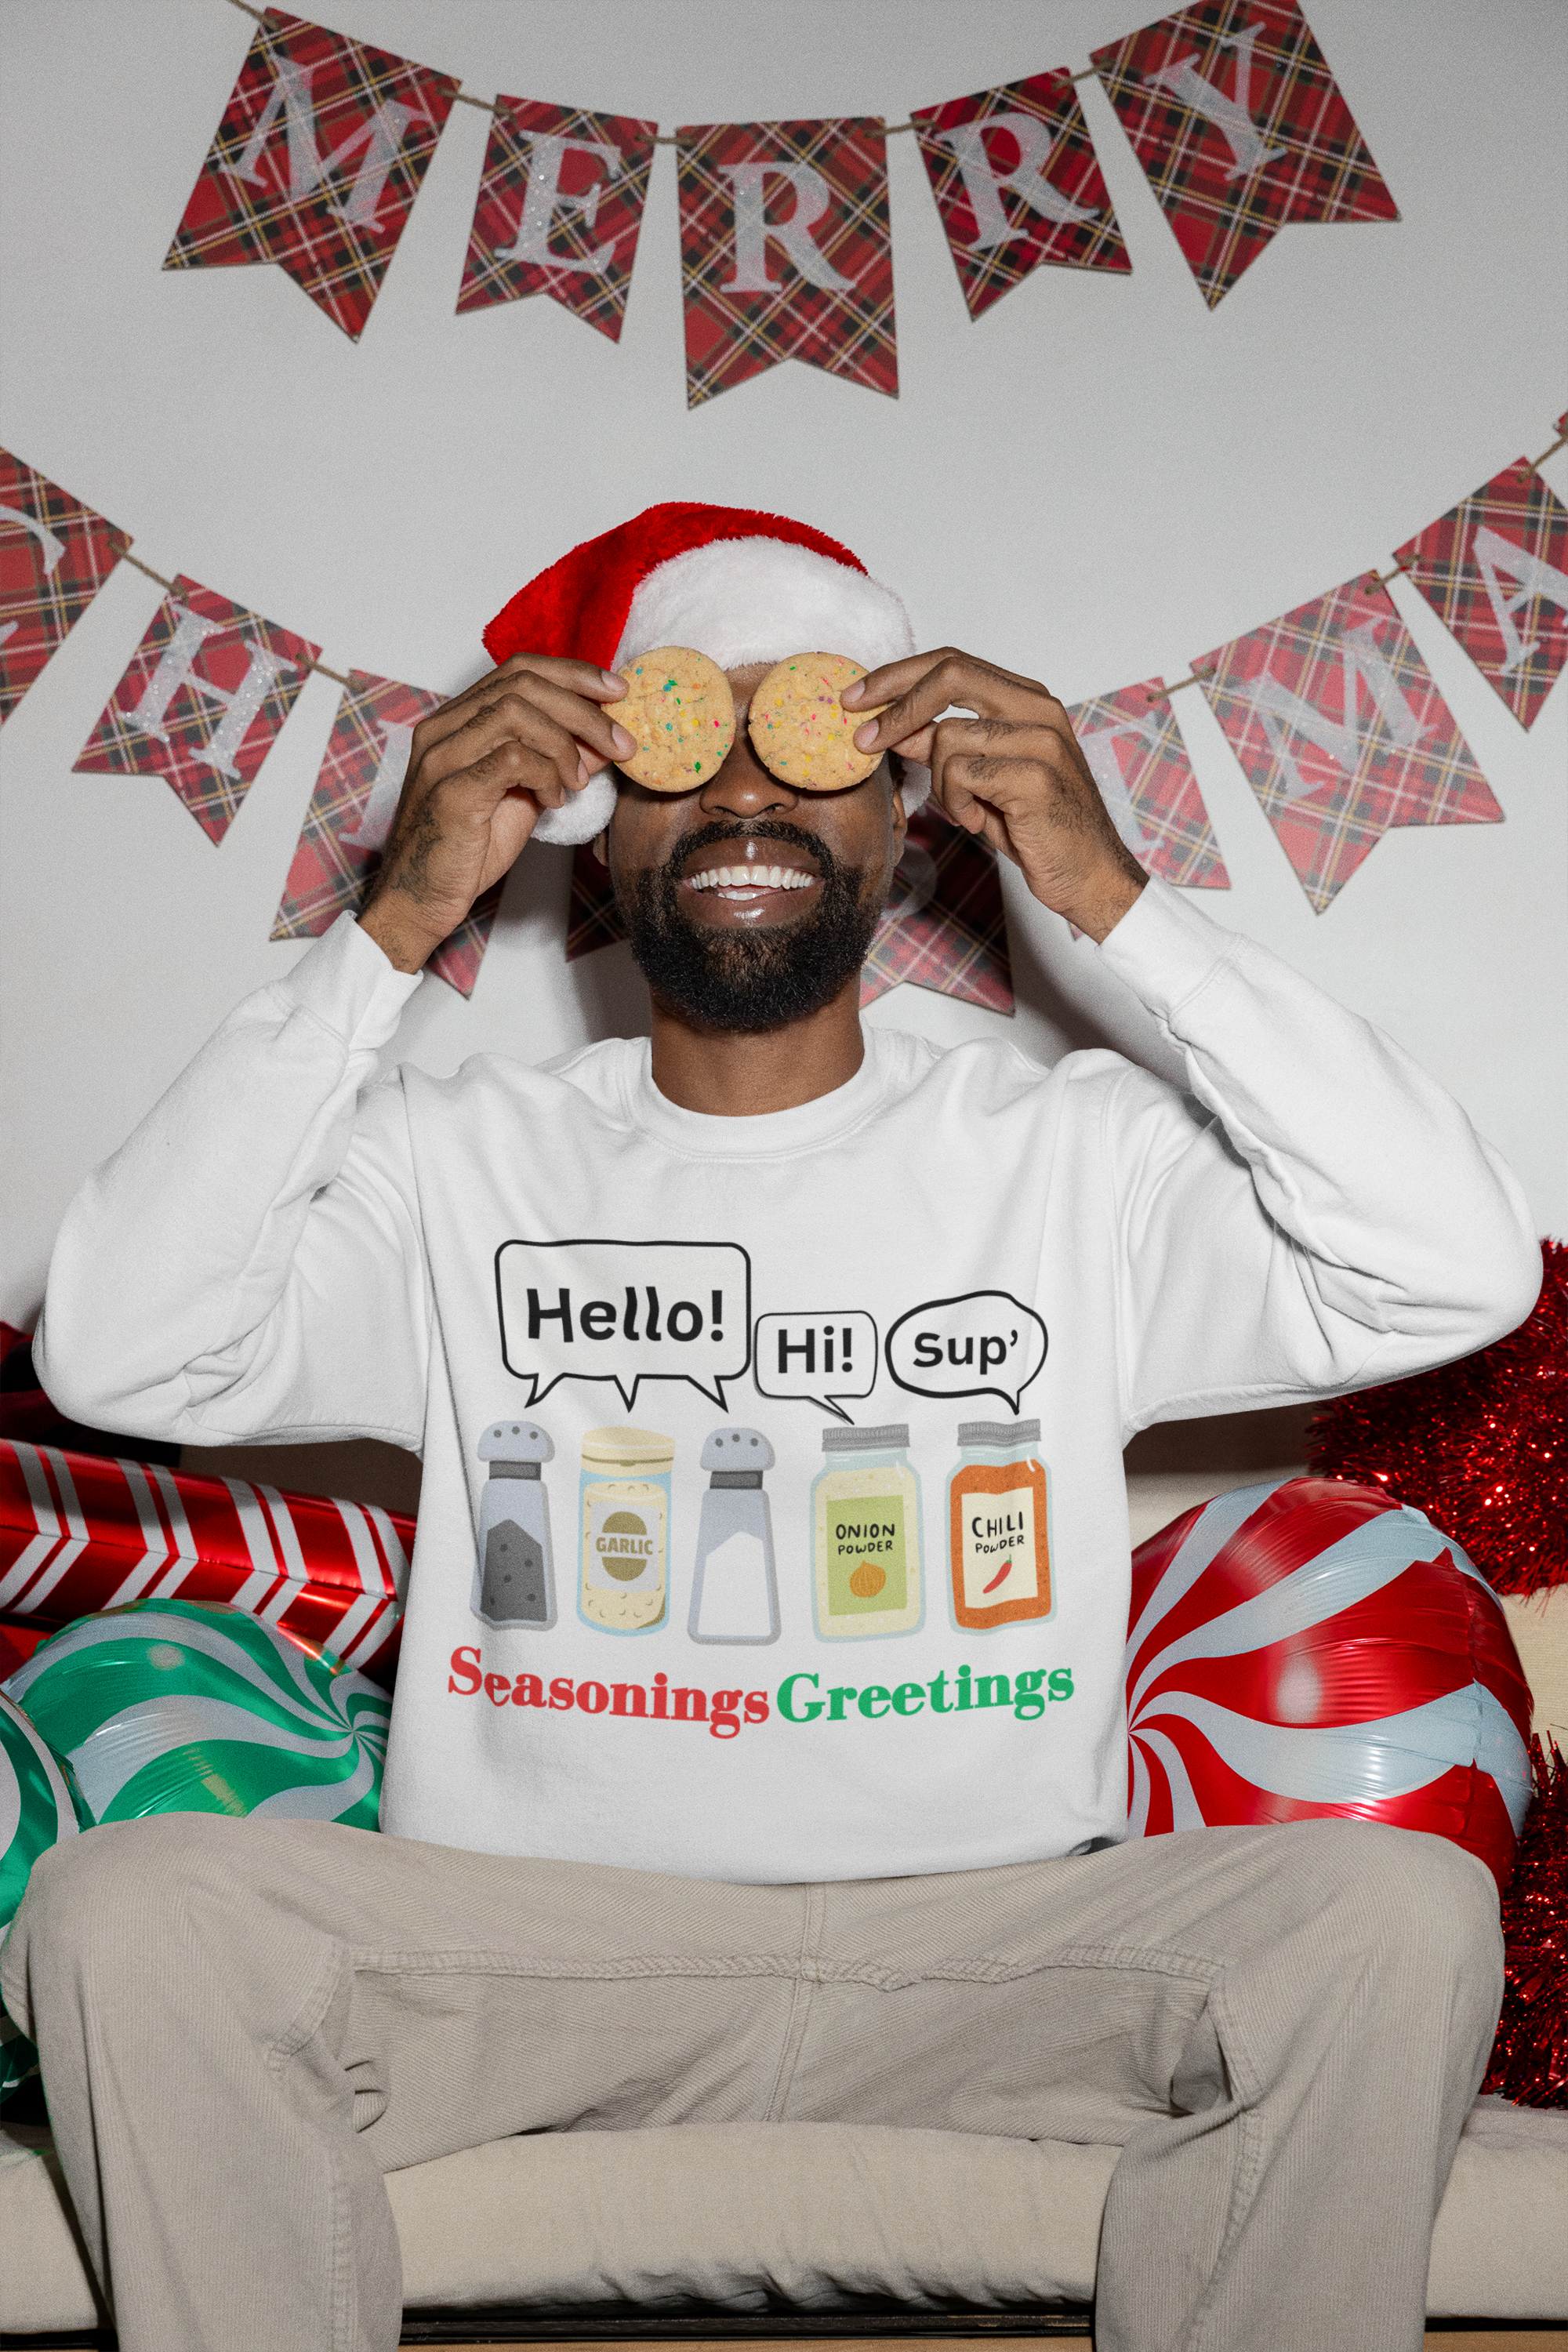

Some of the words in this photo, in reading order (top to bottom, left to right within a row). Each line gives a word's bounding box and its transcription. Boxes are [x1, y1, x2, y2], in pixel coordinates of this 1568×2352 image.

[216, 22, 1288, 293] MERRY
[526, 1286, 724, 1343] Hello!
[778, 1325, 854, 1374] Hi!
[835, 1523, 895, 1541] ONION
[971, 1511, 1024, 1538] CHILI
[596, 1537, 653, 1555] GARLIC
[837, 1540, 893, 1555] POWDER
[974, 1534, 1025, 1554] POWDER
[448, 1646, 770, 1740] Seasonings
[776, 1664, 1075, 1723] Greetings
